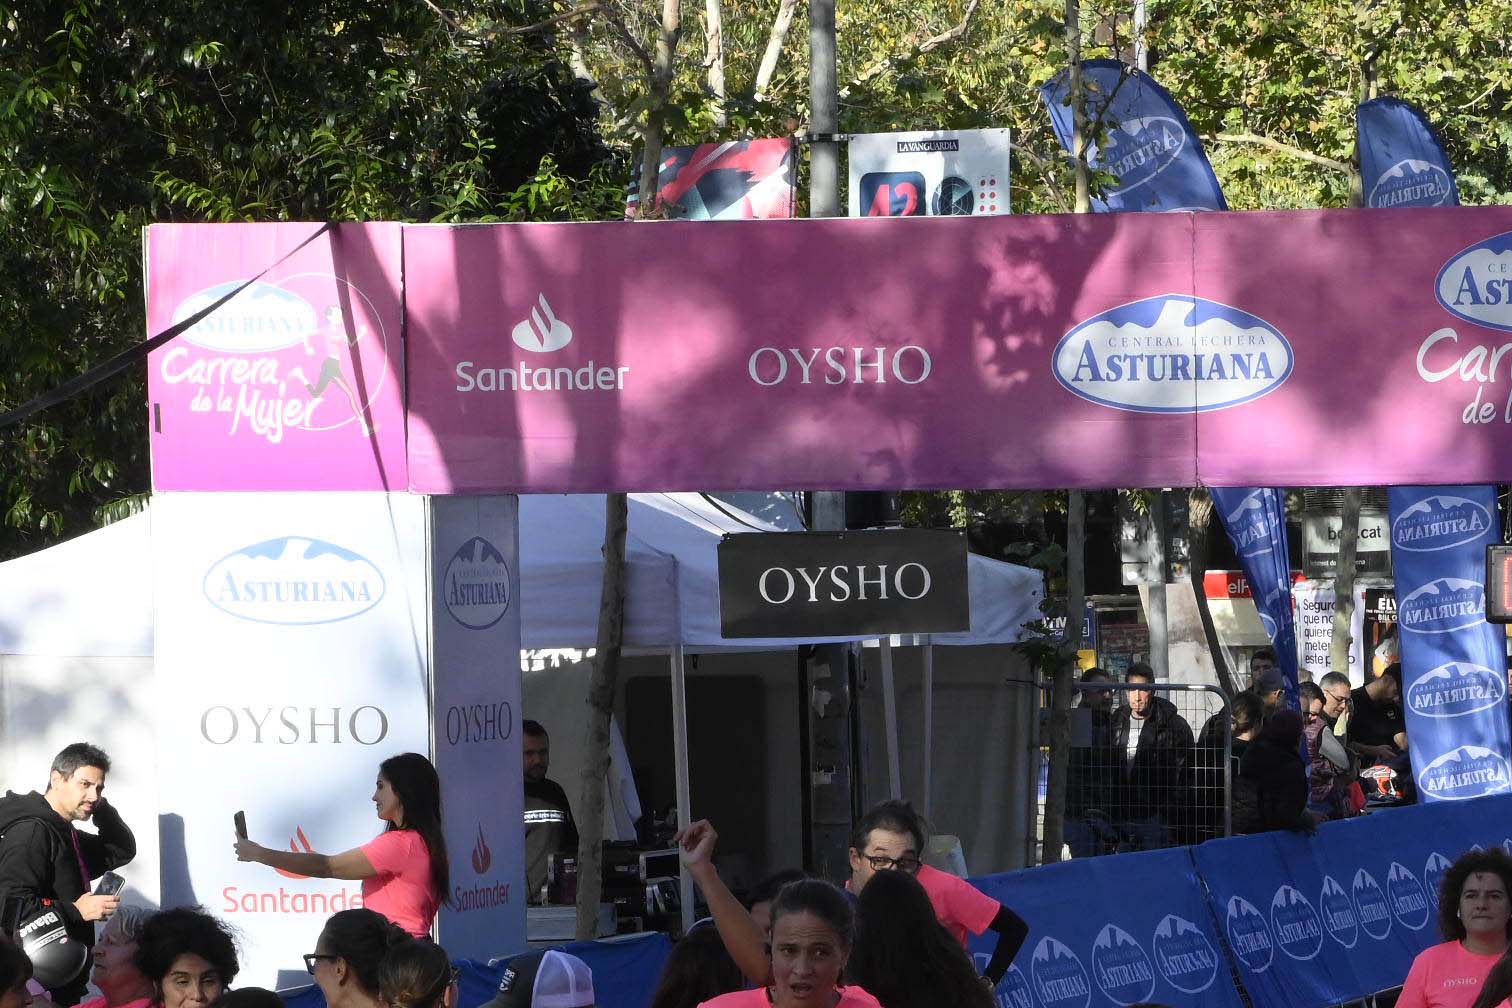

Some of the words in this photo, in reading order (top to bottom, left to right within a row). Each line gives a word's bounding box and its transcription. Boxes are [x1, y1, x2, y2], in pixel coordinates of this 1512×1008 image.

[1108, 336, 1184, 348] CENTRAL
[160, 346, 280, 385] Carrera
[456, 360, 630, 392] Santander
[747, 345, 933, 386] OYSHO
[1071, 346, 1275, 383] ASTURIANA
[190, 387, 213, 413] de
[217, 389, 233, 413] la
[229, 380, 324, 444] Mujer
[1462, 387, 1496, 425] de
[219, 569, 373, 603] ASTURIANA
[450, 572, 507, 606] ASTURIANA
[758, 562, 932, 605] OYSHO
[1304, 627, 1334, 639] quiere
[200, 705, 389, 746] OYSHO
[446, 702, 513, 746] OYSHO
[222, 886, 364, 915] Santande
[454, 881, 511, 913] Santander
[19, 911, 60, 938] Blaue
